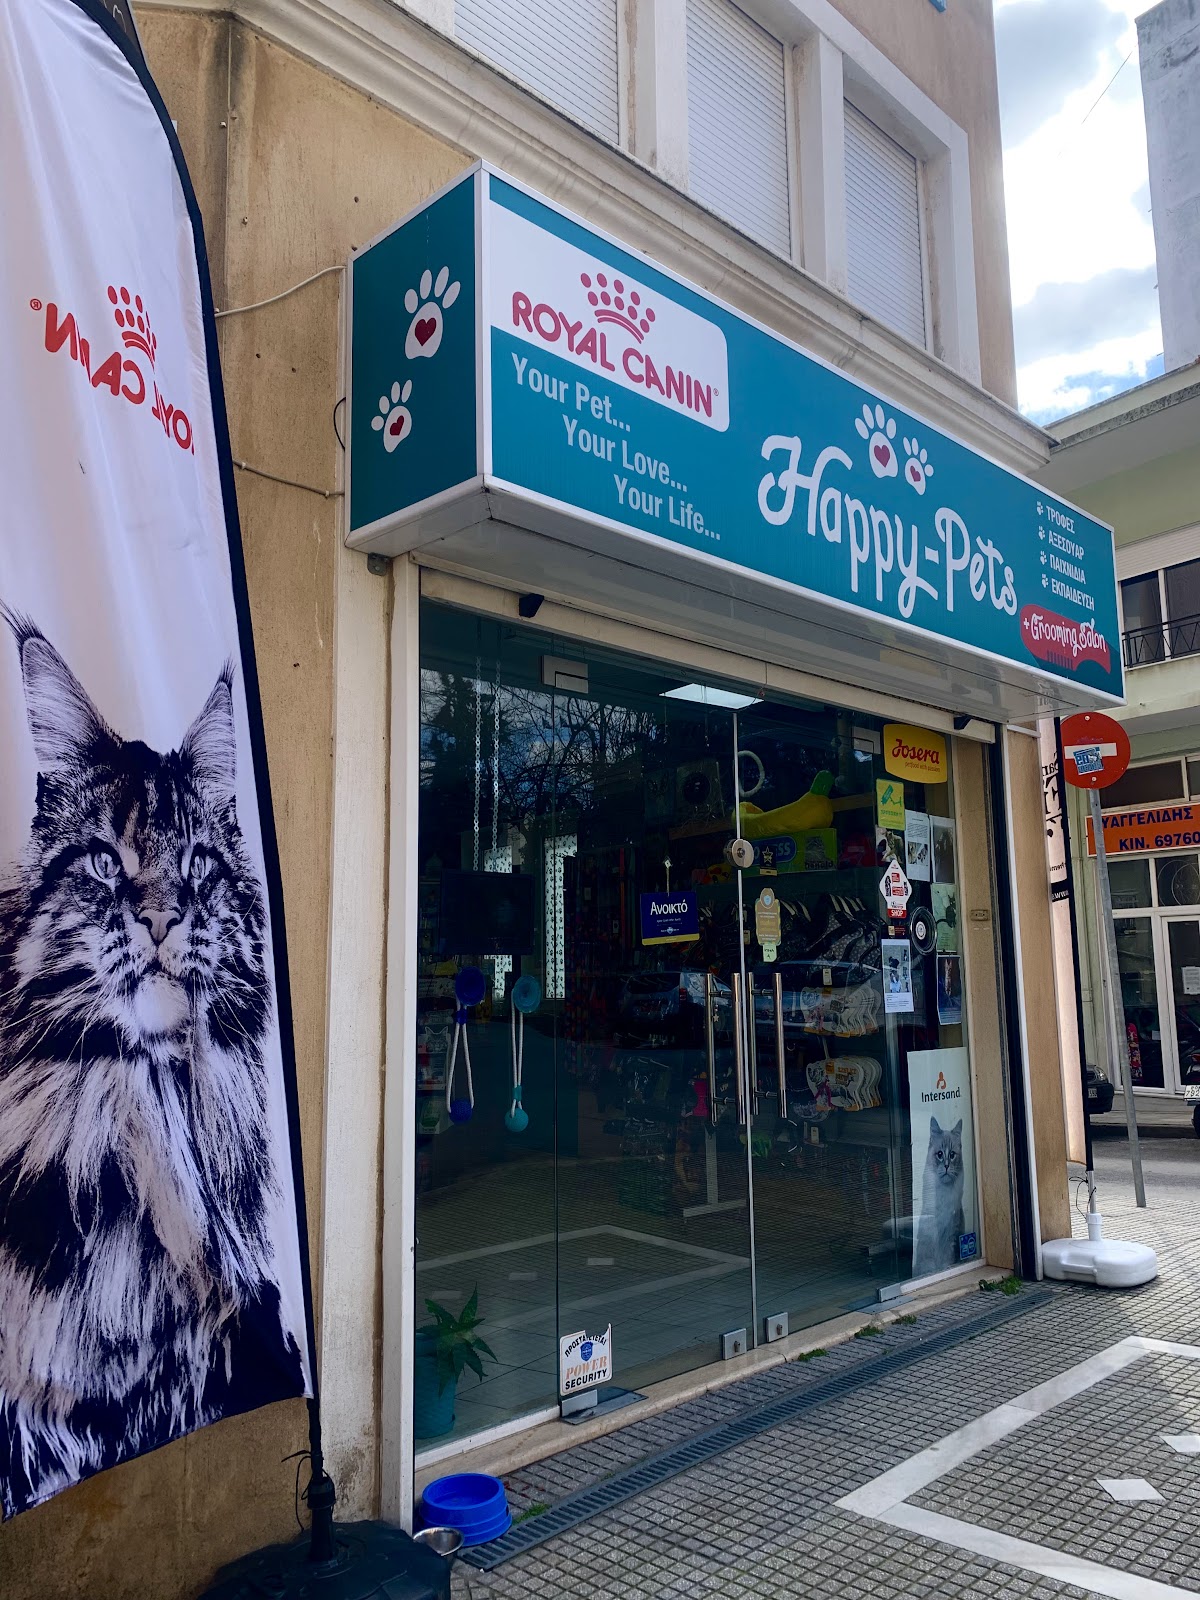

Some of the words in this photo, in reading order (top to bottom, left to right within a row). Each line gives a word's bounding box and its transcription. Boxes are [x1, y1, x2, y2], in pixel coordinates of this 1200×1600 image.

[512, 291, 615, 372] ROYAL
[511, 352, 568, 404] Your
[575, 381, 631, 432] Pet...
[562, 413, 615, 462] Your
[622, 440, 688, 493] Love...
[613, 473, 663, 518] Your
[669, 495, 721, 541] Life...
[1045, 505, 1075, 534] ΤΡΟΦΕΣ
[757, 434, 1018, 618] Happy-Pets
[1048, 530, 1085, 561] ΑΞΕΣΟΥΑΡ
[1049, 553, 1087, 585] ΠΑΙΧΝΙΔΙΑ
[1051, 578, 1095, 612] ΕΚΠΑΙΔΕΥΣΗ
[1078, 617, 1107, 653] Salon
[891, 738, 940, 765] Josera
[1092, 807, 1193, 831] ΥΑΓΓΕΛΙΔΗΣ
[1154, 831, 1200, 847] 69760
[650, 898, 689, 916] Ανοικτό
[921, 1086, 961, 1103] Intersand
[565, 1355, 608, 1380] POWER
[565, 1368, 608, 1390] SECURITY
